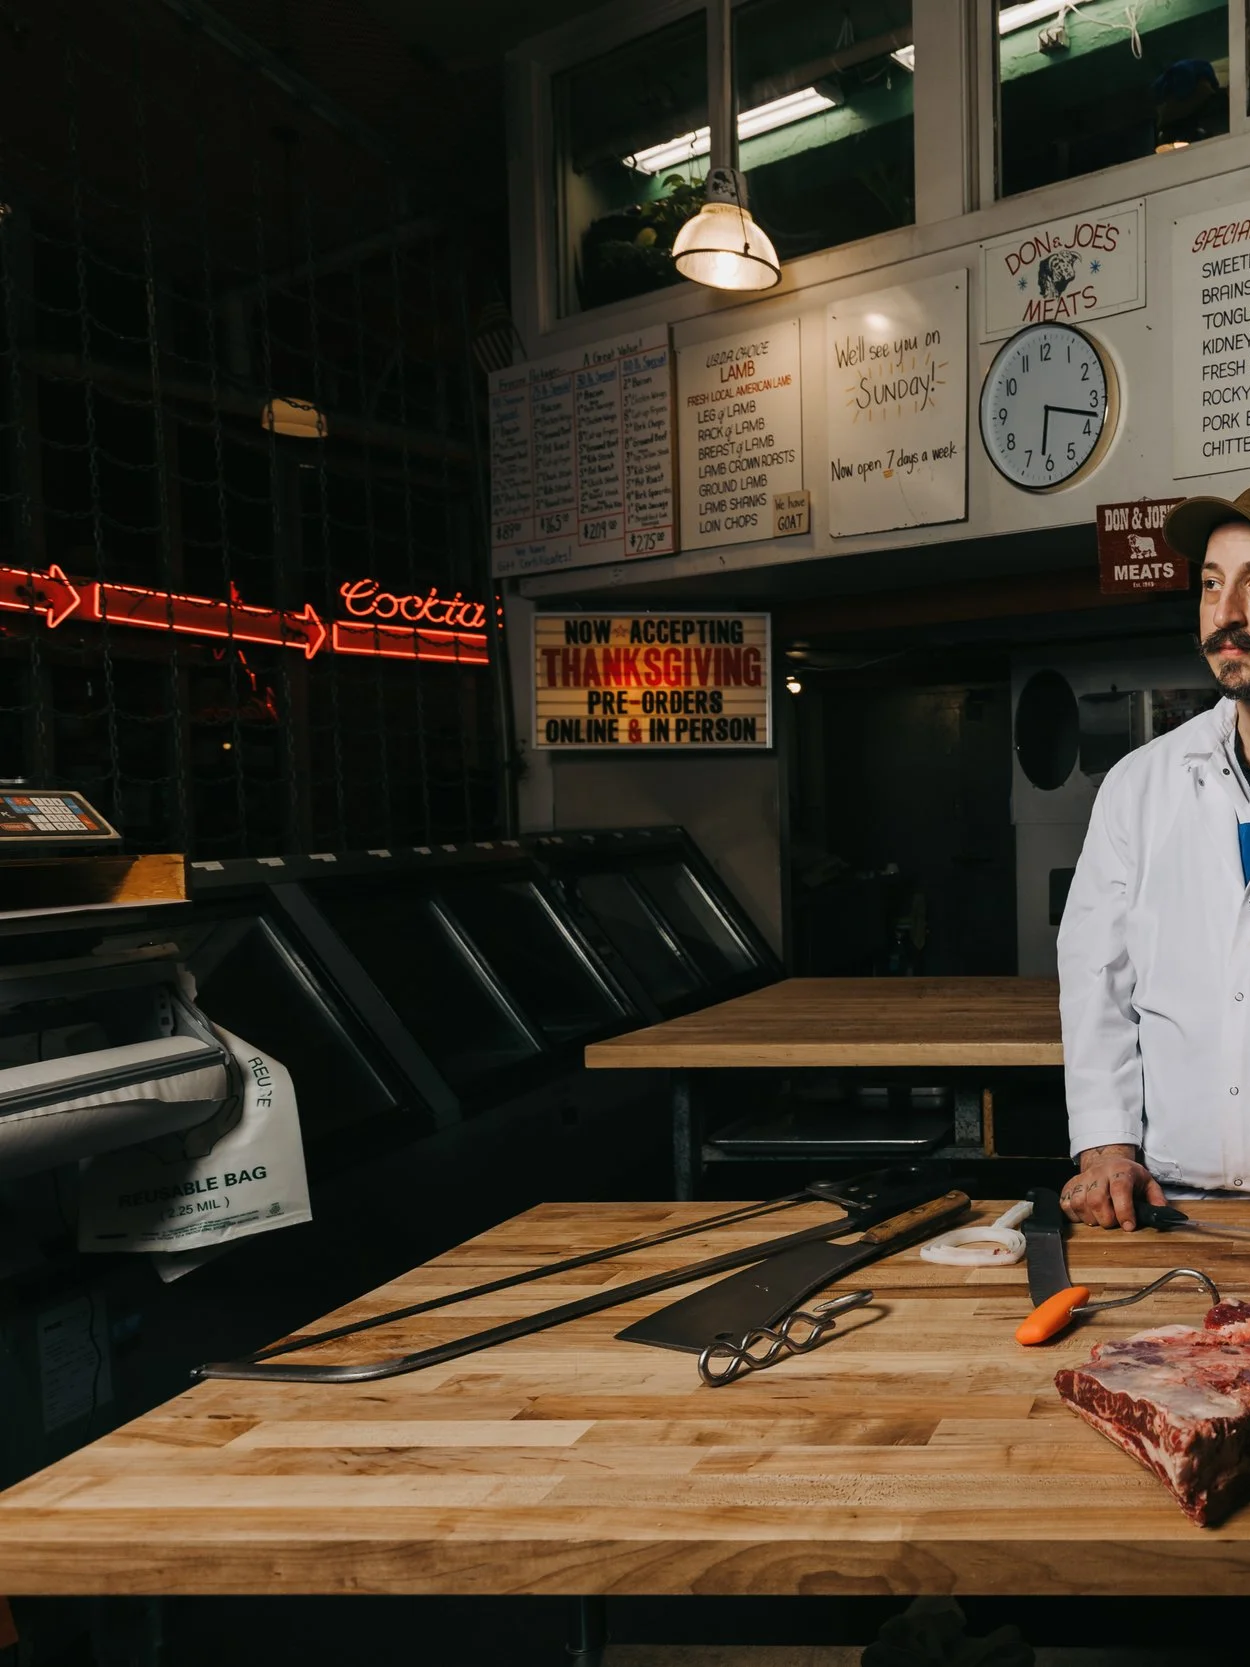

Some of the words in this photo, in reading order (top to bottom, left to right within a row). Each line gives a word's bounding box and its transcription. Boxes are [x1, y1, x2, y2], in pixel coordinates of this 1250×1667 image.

[1004, 232, 1051, 275] DON
[1052, 236, 1062, 248] &
[1064, 223, 1120, 252] JOE'S
[1022, 286, 1098, 322] MEATS
[834, 336, 865, 368] We'll
[869, 344, 890, 362] see
[894, 336, 918, 368] you
[925, 330, 940, 346] on
[1040, 343, 1052, 362] 12
[1067, 345, 1071, 364] 1
[720, 360, 756, 383] LAMB
[1022, 354, 1029, 373] 11
[1080, 362, 1090, 382] 2
[1202, 360, 1246, 382] FRESH
[687, 394, 708, 408] FRESH
[711, 388, 734, 402] LOCAL
[736, 380, 772, 396] AMERICAN
[773, 374, 792, 388] LAMB
[1006, 378, 1017, 396] 10
[1090, 390, 1098, 408] 3
[698, 408, 716, 424] LEG
[727, 400, 756, 418] LAMB
[998, 408, 1008, 426] 9
[1202, 412, 1240, 432] PORK
[698, 426, 724, 442] RACK
[736, 418, 765, 435] LAMB
[1082, 418, 1092, 436] 4
[698, 442, 736, 461] BREAST
[745, 434, 774, 452] LAMB
[1006, 432, 1016, 450] 8
[1066, 442, 1076, 460] 5
[699, 462, 727, 479] LAMB
[728, 456, 760, 474] CROWN
[762, 450, 796, 467] ROASTS
[831, 458, 852, 482] Now
[858, 460, 882, 482] open
[886, 450, 896, 468] 7
[896, 448, 919, 474] days
[922, 451, 928, 462] a
[932, 441, 957, 460] week
[1025, 450, 1032, 468] 7
[1046, 454, 1054, 472] 6
[699, 480, 738, 497] GROUND
[740, 474, 768, 490] LAMB
[700, 499, 728, 516] LAMB
[730, 493, 767, 511] SHANKS
[700, 520, 720, 534] LOIN
[724, 513, 758, 530] CHOPS
[778, 513, 804, 531] GOAT
[1104, 508, 1129, 532] DON
[1132, 507, 1142, 530] &
[1114, 562, 1174, 580] MEATS
[564, 620, 612, 644] NOW
[630, 620, 744, 644] ACCEPTING
[542, 647, 762, 688] THANKSGIVING
[587, 690, 724, 716] PRE-ORDERS
[546, 718, 619, 744] ONLINE
[628, 718, 642, 744] &
[649, 718, 670, 742] IN
[675, 718, 756, 742] PERSON
[118, 1176, 220, 1208] REUSABLE
[224, 1166, 268, 1187] BAG
[168, 1203, 194, 1218] 2.25
[198, 1199, 221, 1212] MIL
